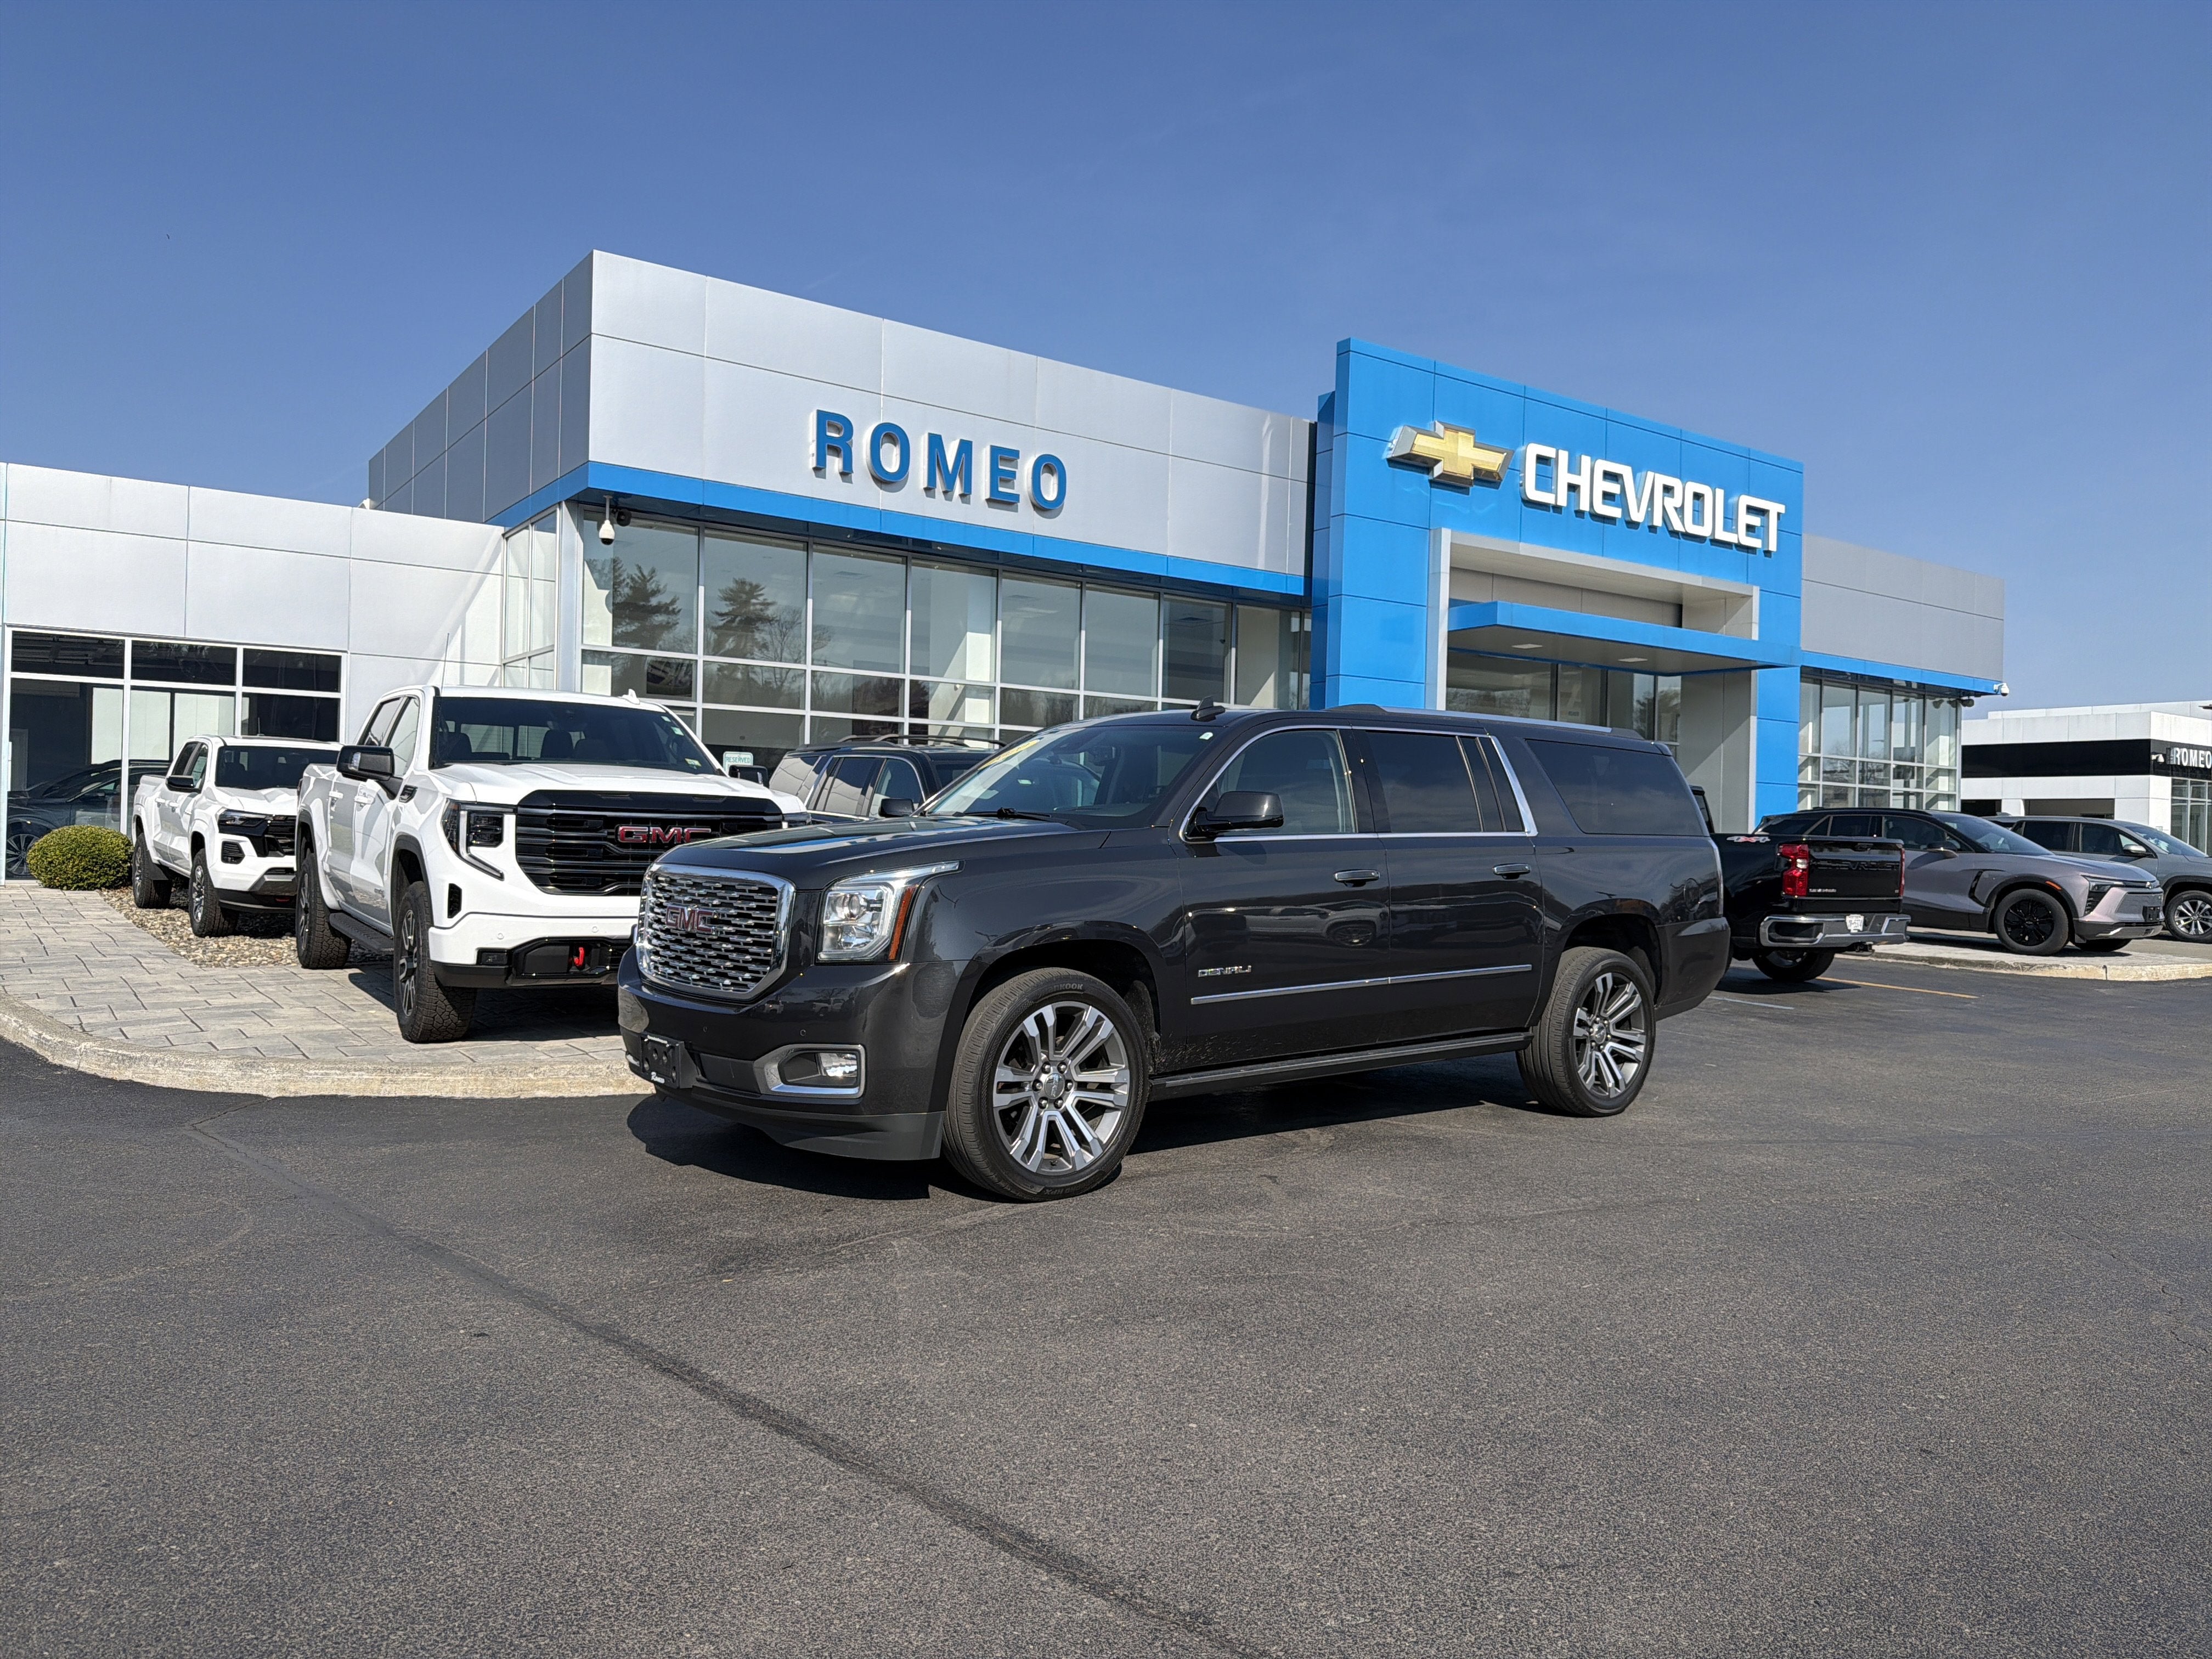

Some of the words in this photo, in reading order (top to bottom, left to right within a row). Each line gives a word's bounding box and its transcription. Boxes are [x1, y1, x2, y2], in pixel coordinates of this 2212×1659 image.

[813, 409, 1066, 510] ROMEO
[1523, 443, 1786, 552] CHEVROLET
[2172, 747, 2212, 769] ROMEO
[619, 826, 711, 844] GMC
[666, 905, 714, 933] GMC
[1198, 966, 1251, 977] DENALI
